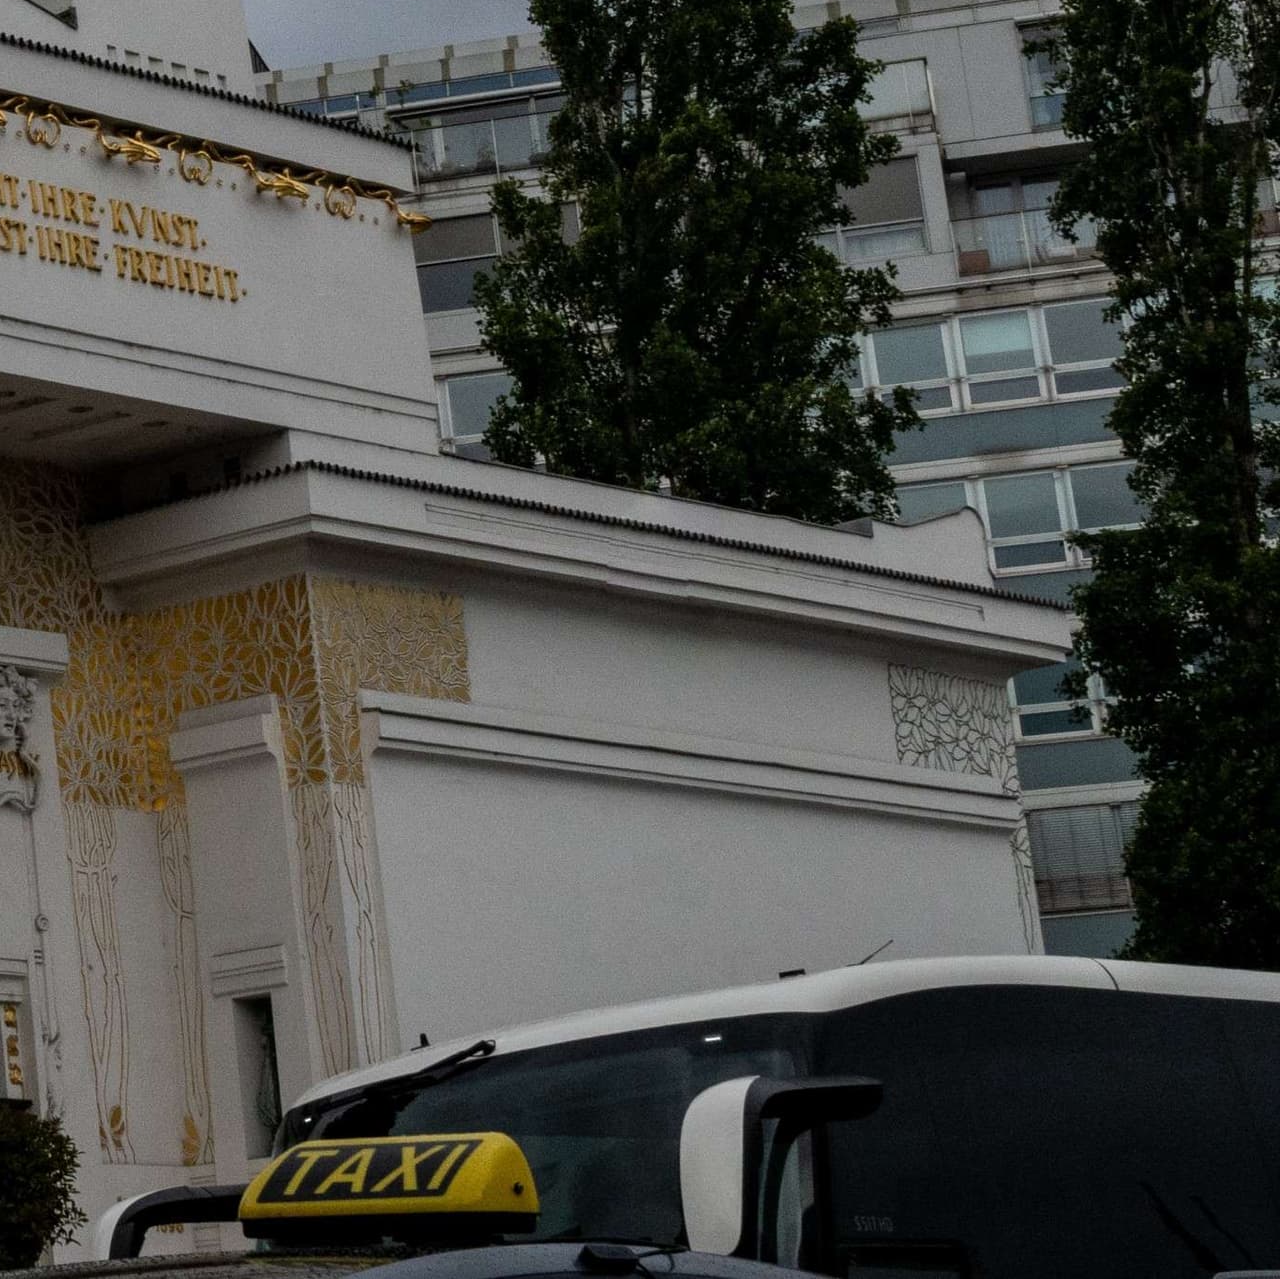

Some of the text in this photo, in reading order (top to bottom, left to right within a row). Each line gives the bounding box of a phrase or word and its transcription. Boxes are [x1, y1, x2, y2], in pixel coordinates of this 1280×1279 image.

[28, 179, 100, 228] IHRE
[36, 225, 102, 272] IHRE
[283, 1143, 471, 1197] TAXI
